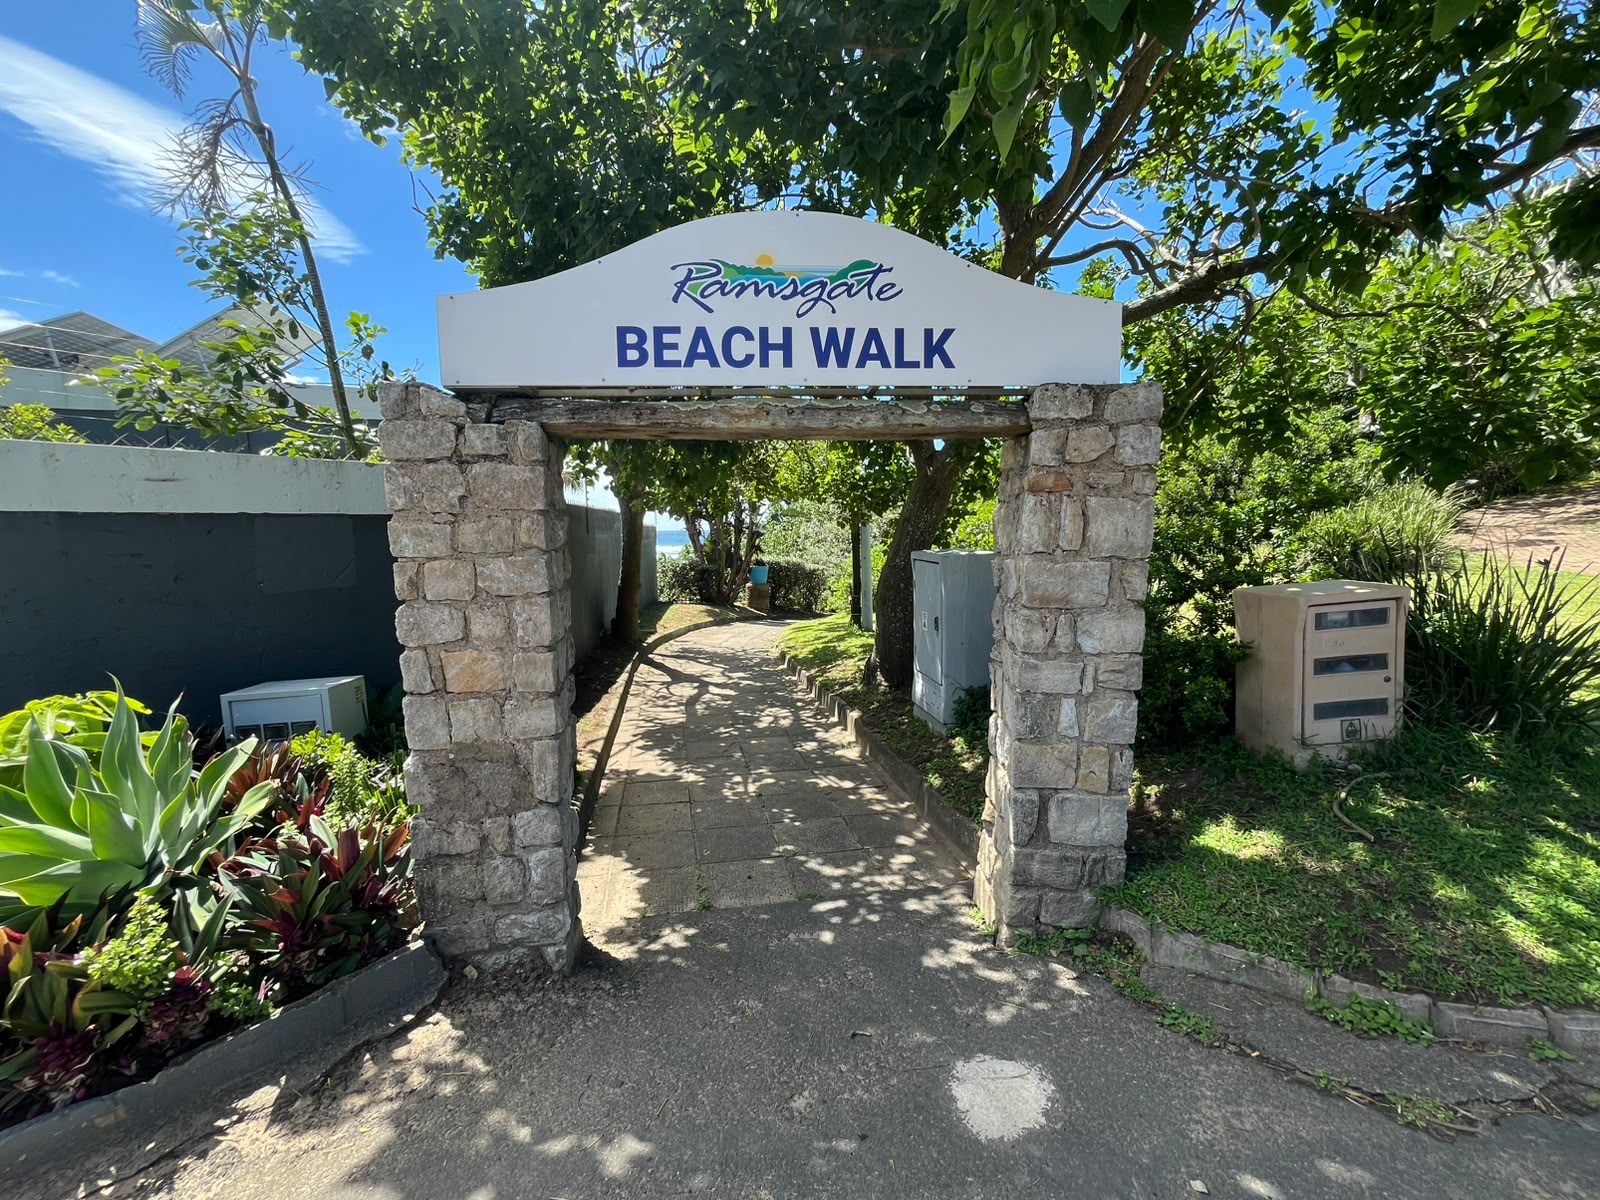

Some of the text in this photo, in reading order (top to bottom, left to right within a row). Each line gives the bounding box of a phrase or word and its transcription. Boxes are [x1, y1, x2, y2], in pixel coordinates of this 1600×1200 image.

[671, 261, 904, 318] Ramsgate
[616, 326, 956, 369] BEACH WALK
